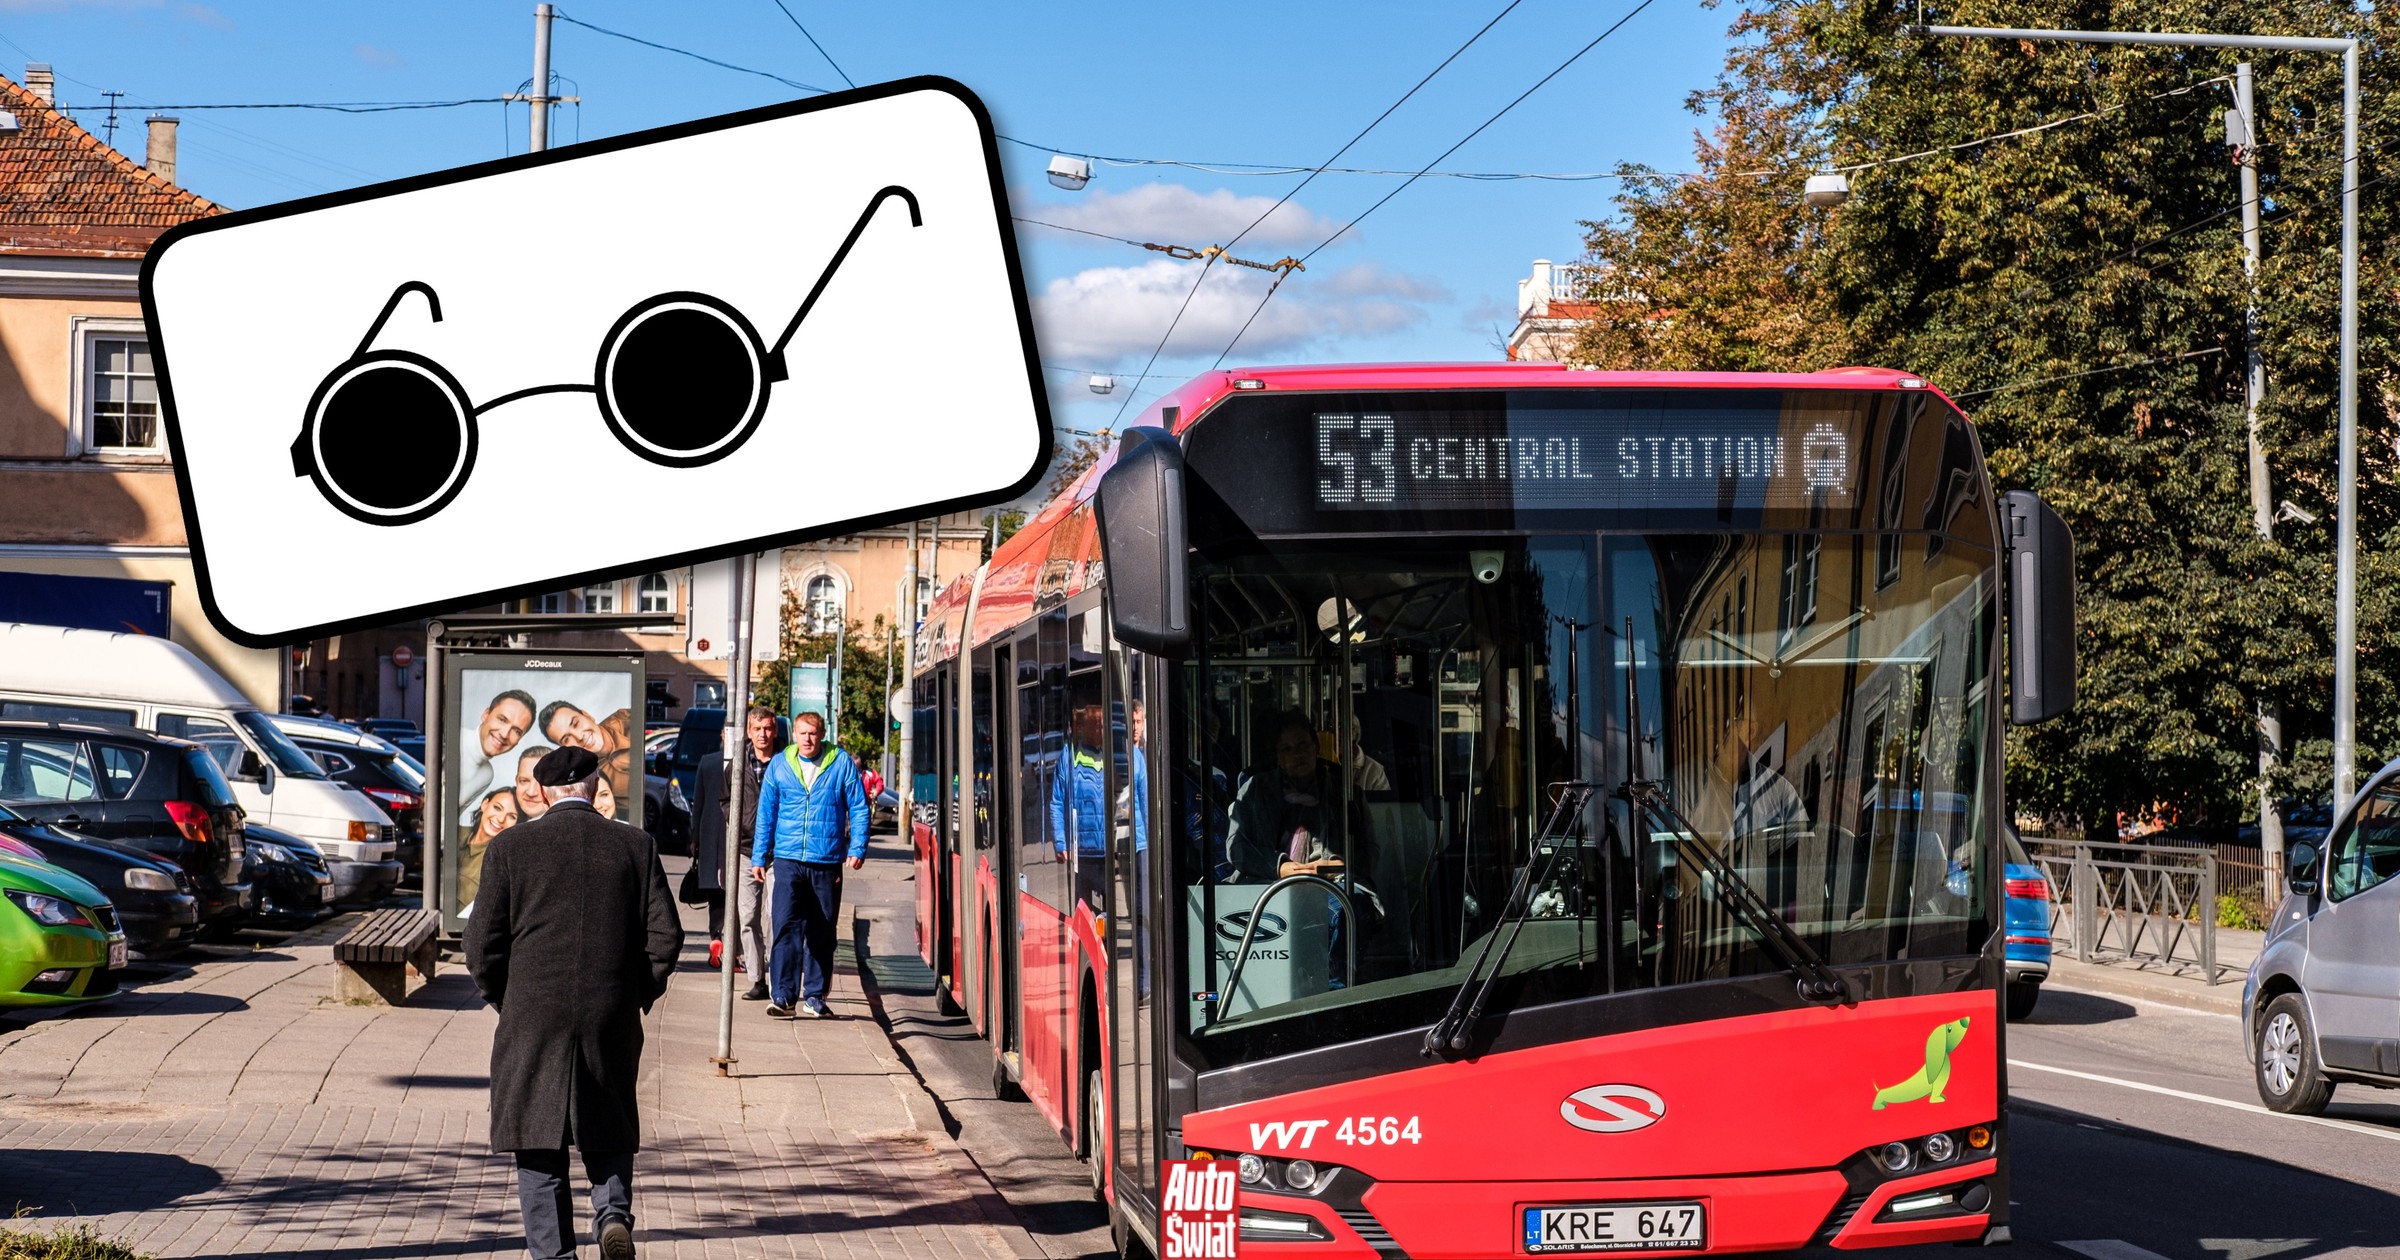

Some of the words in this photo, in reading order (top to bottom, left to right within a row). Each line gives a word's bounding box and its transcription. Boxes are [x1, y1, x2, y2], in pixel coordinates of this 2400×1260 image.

[1319, 415, 1395, 502] 53
[1411, 437, 1593, 479] CENTRAL
[1618, 436, 1785, 478] STATION
[524, 659, 562, 668] JCDecaux
[1215, 950, 1290, 960] SOARIS
[1335, 1116, 1422, 1145] 4564
[1545, 1211, 1615, 1241] KRE
[1638, 1209, 1696, 1239] 647
[1527, 1231, 1540, 1239] LT
